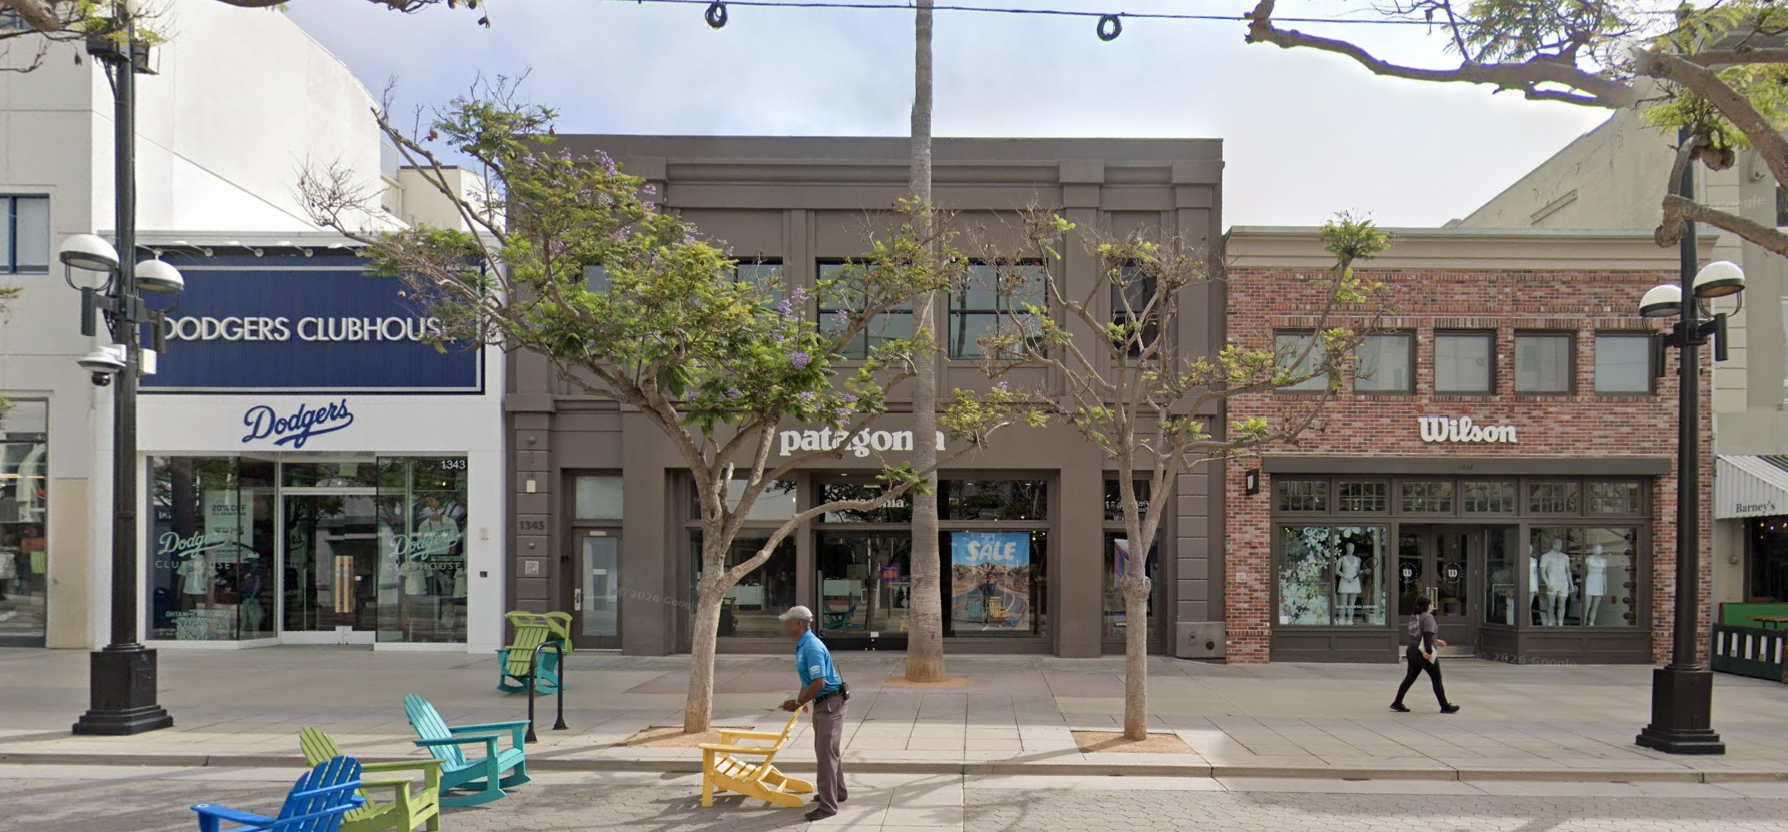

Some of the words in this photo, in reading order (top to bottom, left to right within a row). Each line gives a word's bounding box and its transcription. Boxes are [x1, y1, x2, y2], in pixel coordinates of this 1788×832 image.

[164, 316, 291, 341] DODGERS
[297, 316, 456, 341] CLUBHOUS
[242, 399, 354, 449] Dodgers
[1418, 415, 1518, 443] Wilson
[779, 426, 946, 458] patagona
[441, 460, 466, 470] 1343
[1735, 501, 1776, 514] Barney's
[518, 520, 545, 530] 1345
[965, 541, 1017, 561] SALE
